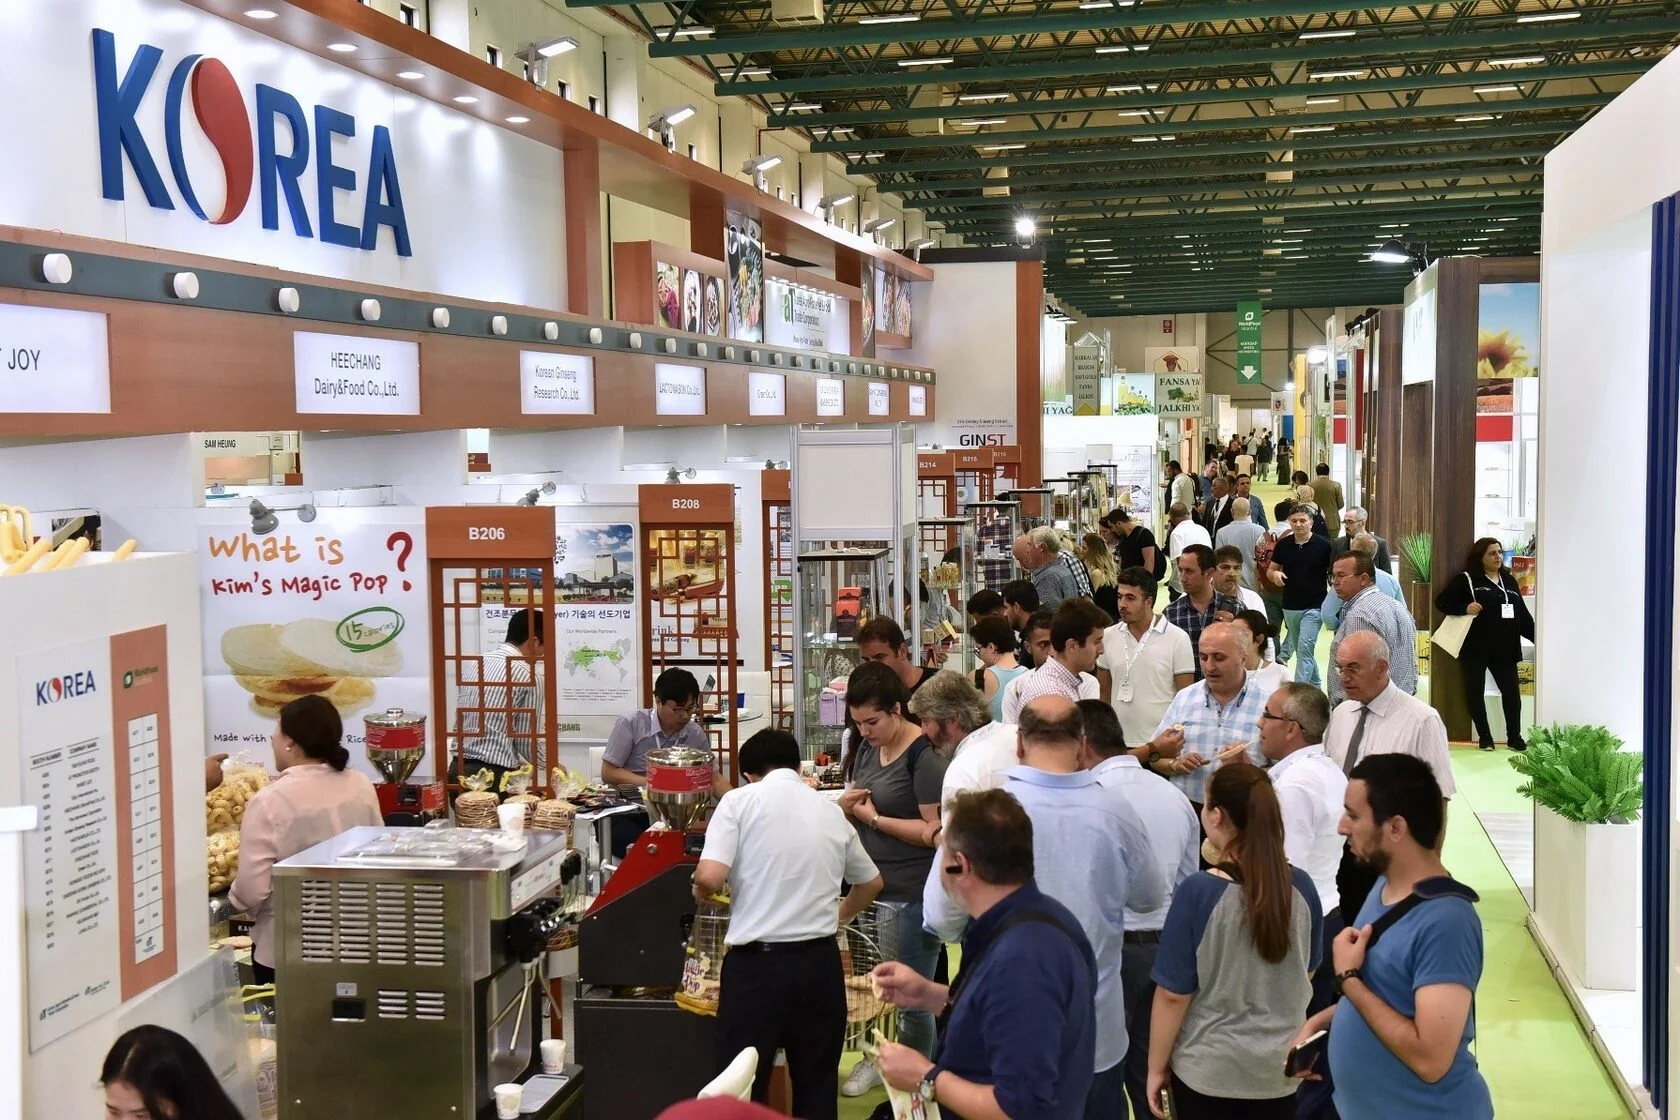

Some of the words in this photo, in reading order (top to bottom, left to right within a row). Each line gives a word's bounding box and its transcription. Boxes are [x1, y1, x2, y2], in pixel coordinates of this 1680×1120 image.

[92, 28, 412, 257] KOREA
[8, 348, 41, 371] JOY
[331, 352, 381, 370] HEECHANG
[535, 365, 555, 379] Korean
[556, 366, 577, 384] Ginseng
[314, 378, 365, 399] Dairy&Food
[367, 380, 400, 398] Co.,Ltd.
[1159, 378, 1190, 386] FANSA
[534, 385, 560, 400] Research
[1158, 404, 1191, 413] JALKHI
[204, 439, 217, 448] SAM
[217, 439, 237, 448] HEUNG
[959, 433, 1007, 446] GINST
[672, 499, 700, 509] B208
[468, 526, 506, 540] B206
[315, 536, 344, 565] is
[281, 574, 341, 601] Magic
[571, 609, 596, 618] 기술의
[598, 609, 631, 619] 선도기업
[345, 620, 364, 641] 15
[652, 625, 674, 635] rink
[36, 670, 96, 706] KOREA
[214, 733, 239, 742] Made
[243, 733, 267, 743] with
[346, 734, 368, 744] Rice
